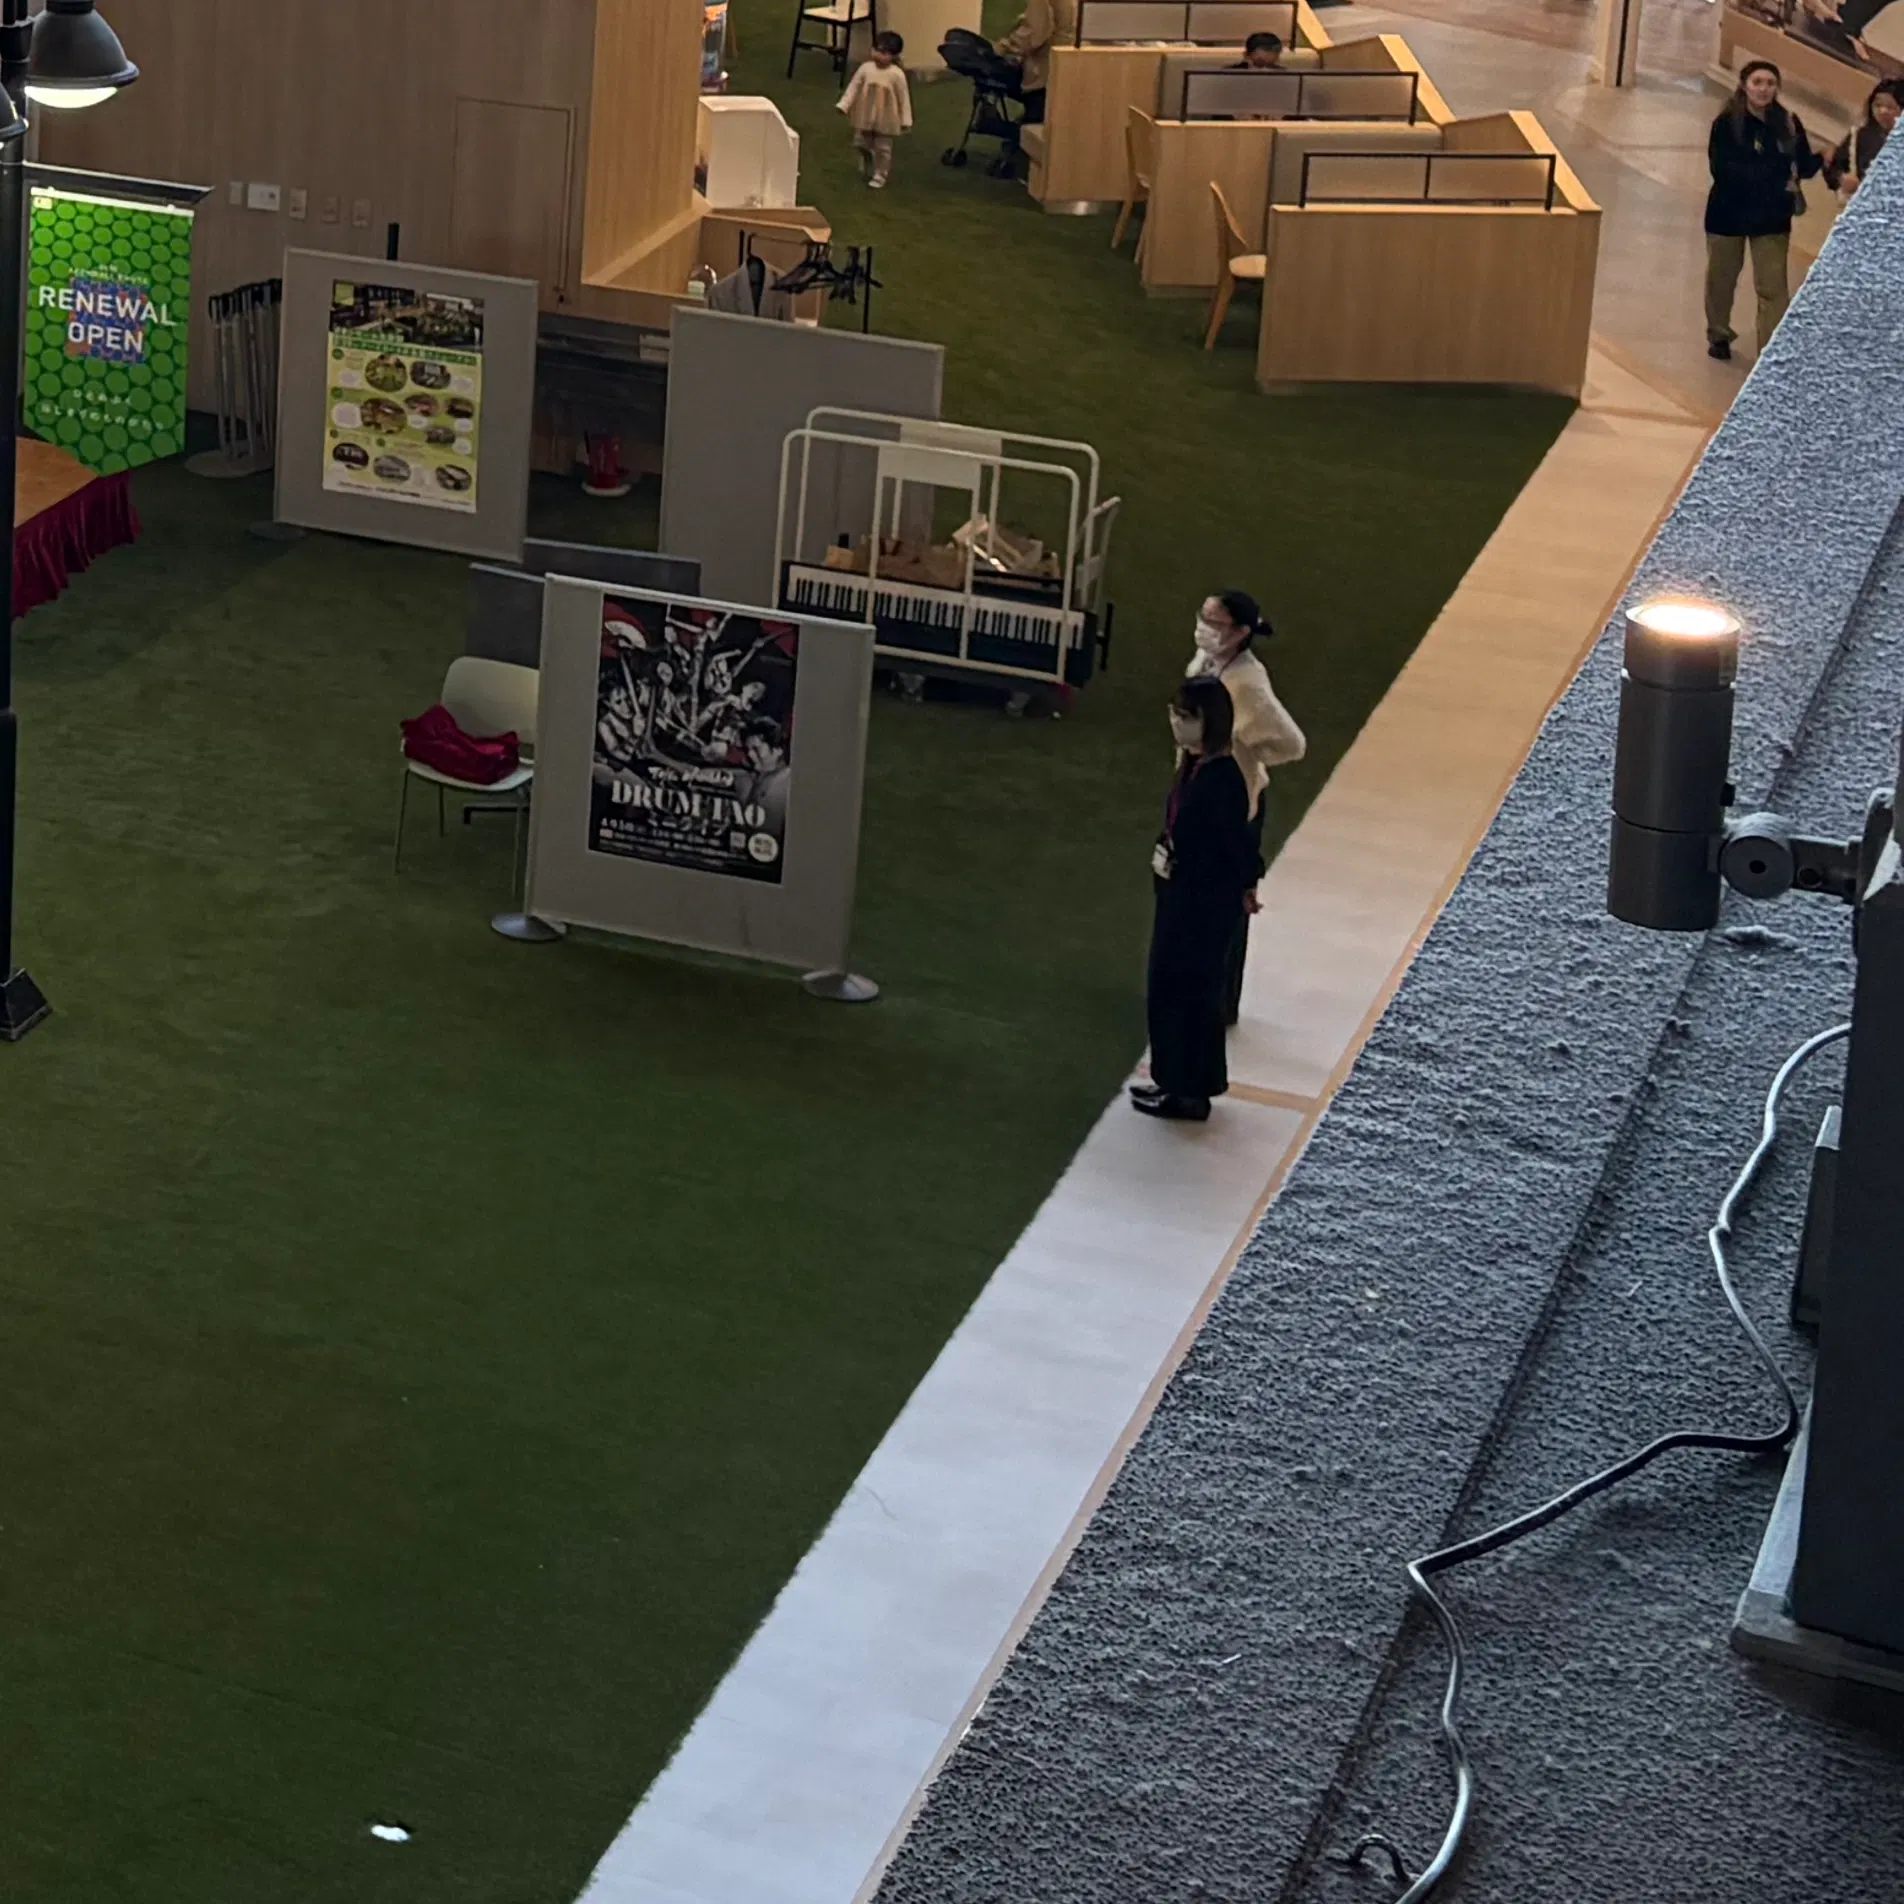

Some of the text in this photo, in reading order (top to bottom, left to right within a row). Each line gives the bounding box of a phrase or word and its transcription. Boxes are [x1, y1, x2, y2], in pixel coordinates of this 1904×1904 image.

[38, 285, 178, 327] RENEWAL
[67, 321, 144, 353] OPEN
[611, 779, 766, 828] DRUM TAO
